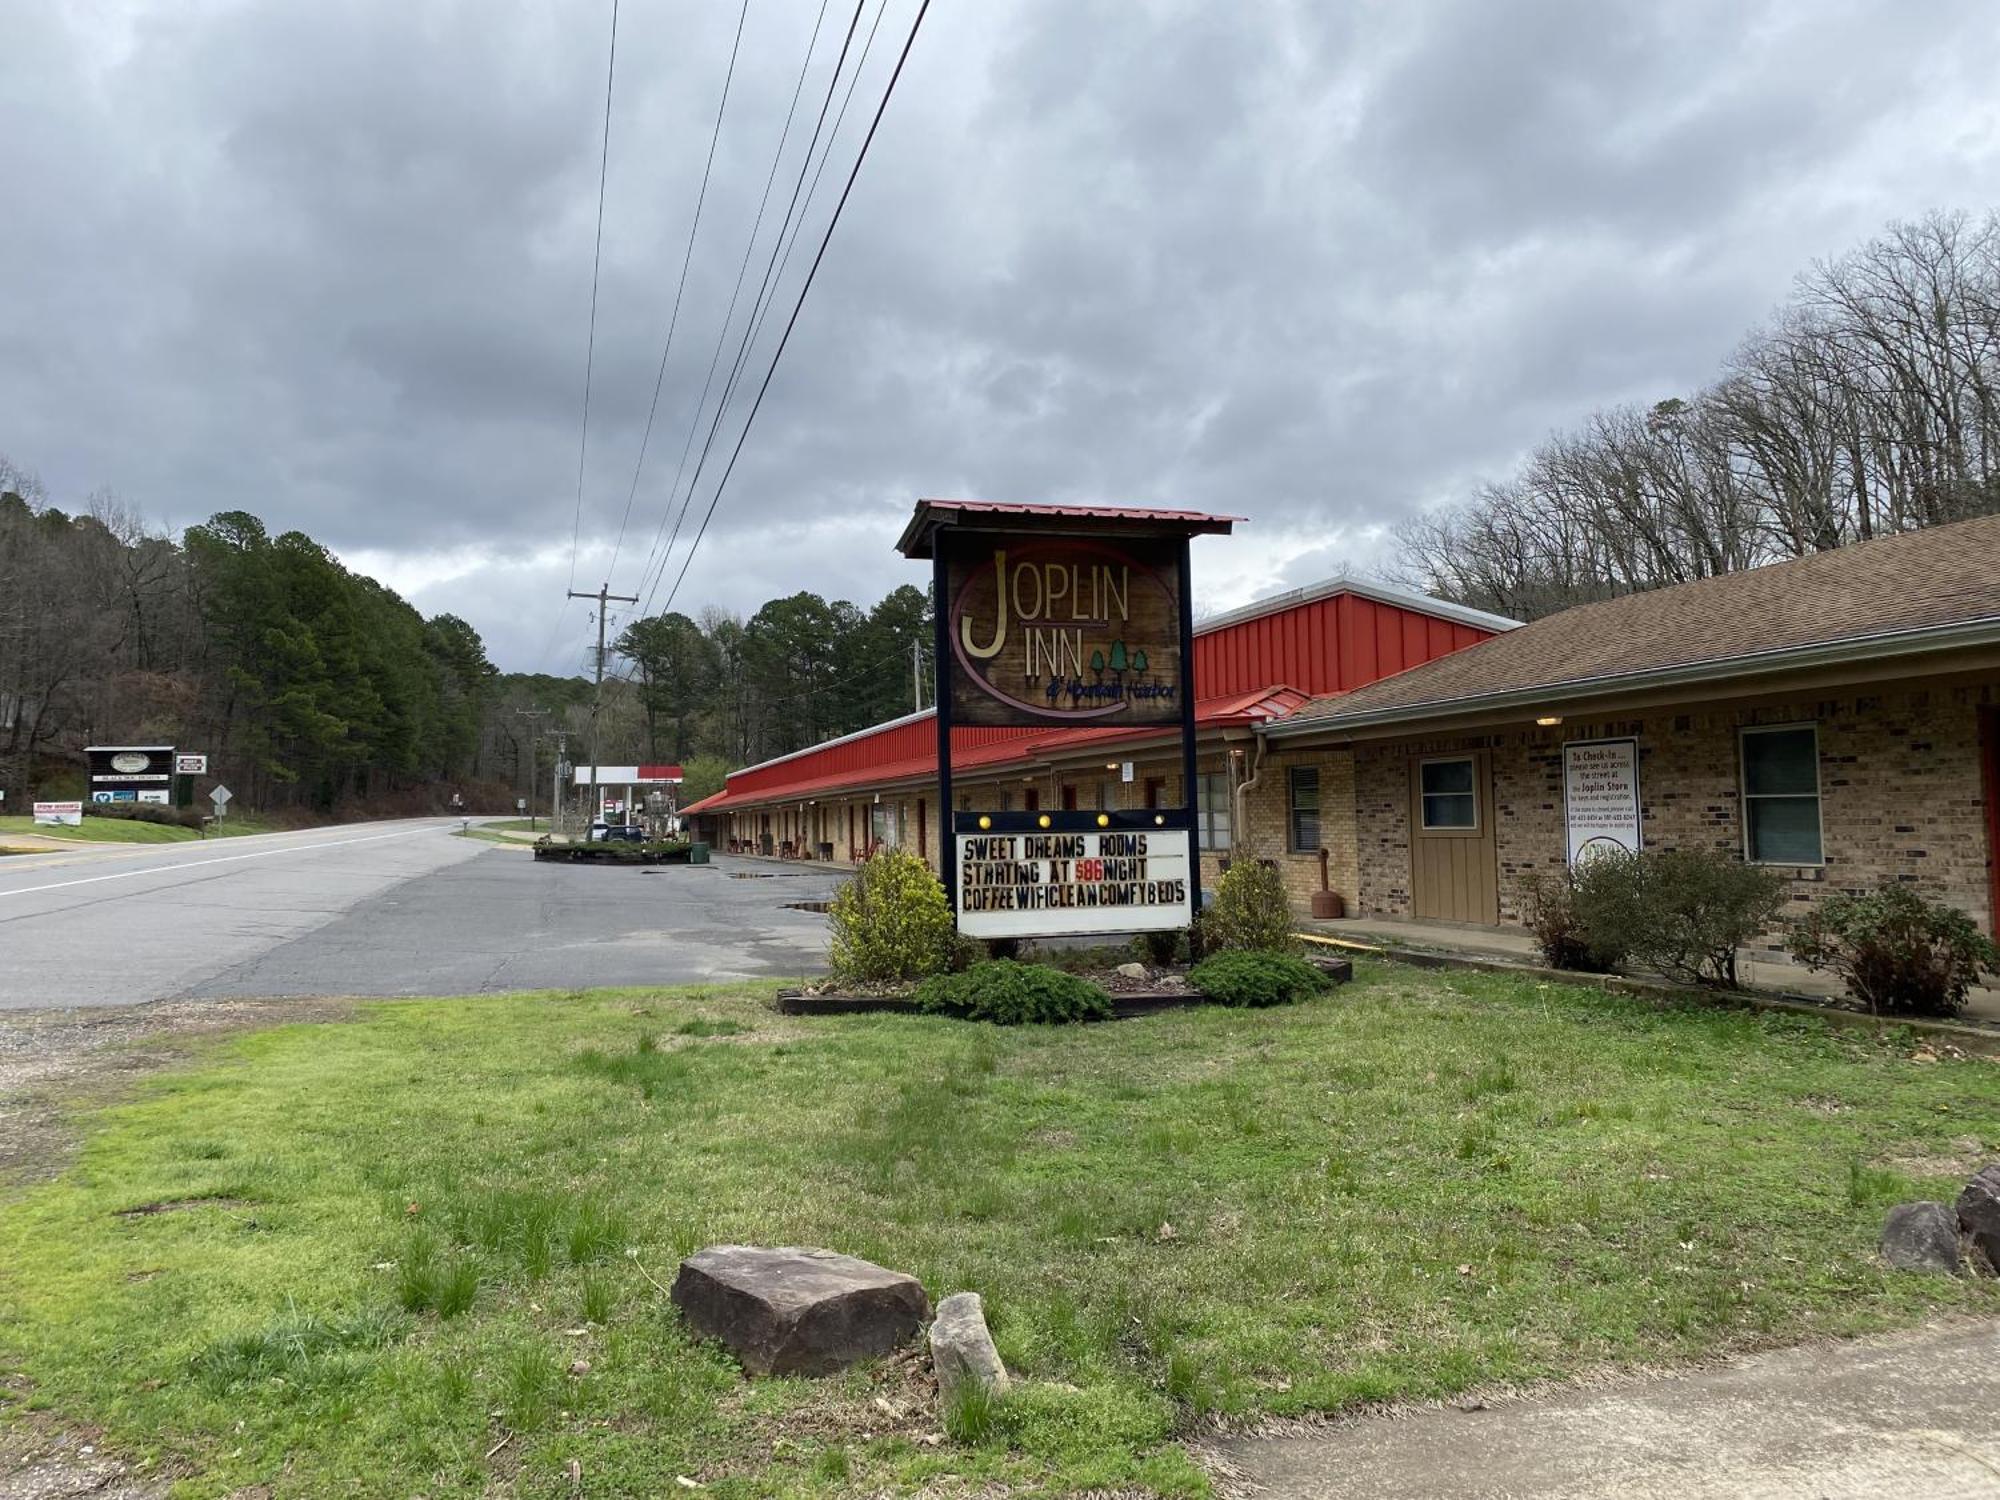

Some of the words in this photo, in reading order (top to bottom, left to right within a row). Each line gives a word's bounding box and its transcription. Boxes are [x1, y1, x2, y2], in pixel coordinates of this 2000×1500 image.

[962, 550, 1128, 658] JOPLIN
[1025, 628, 1081, 677] INN
[1126, 678, 1175, 698] Harbor
[1582, 783, 1605, 794] Joplin
[1607, 782, 1629, 791] Store
[964, 837, 1017, 860] SWEET
[1024, 835, 1085, 859] DREAMS
[1099, 834, 1147, 857] ROOMS
[963, 860, 1039, 885] STARTING
[1049, 860, 1070, 883] AT
[1103, 858, 1147, 881] NIGHT
